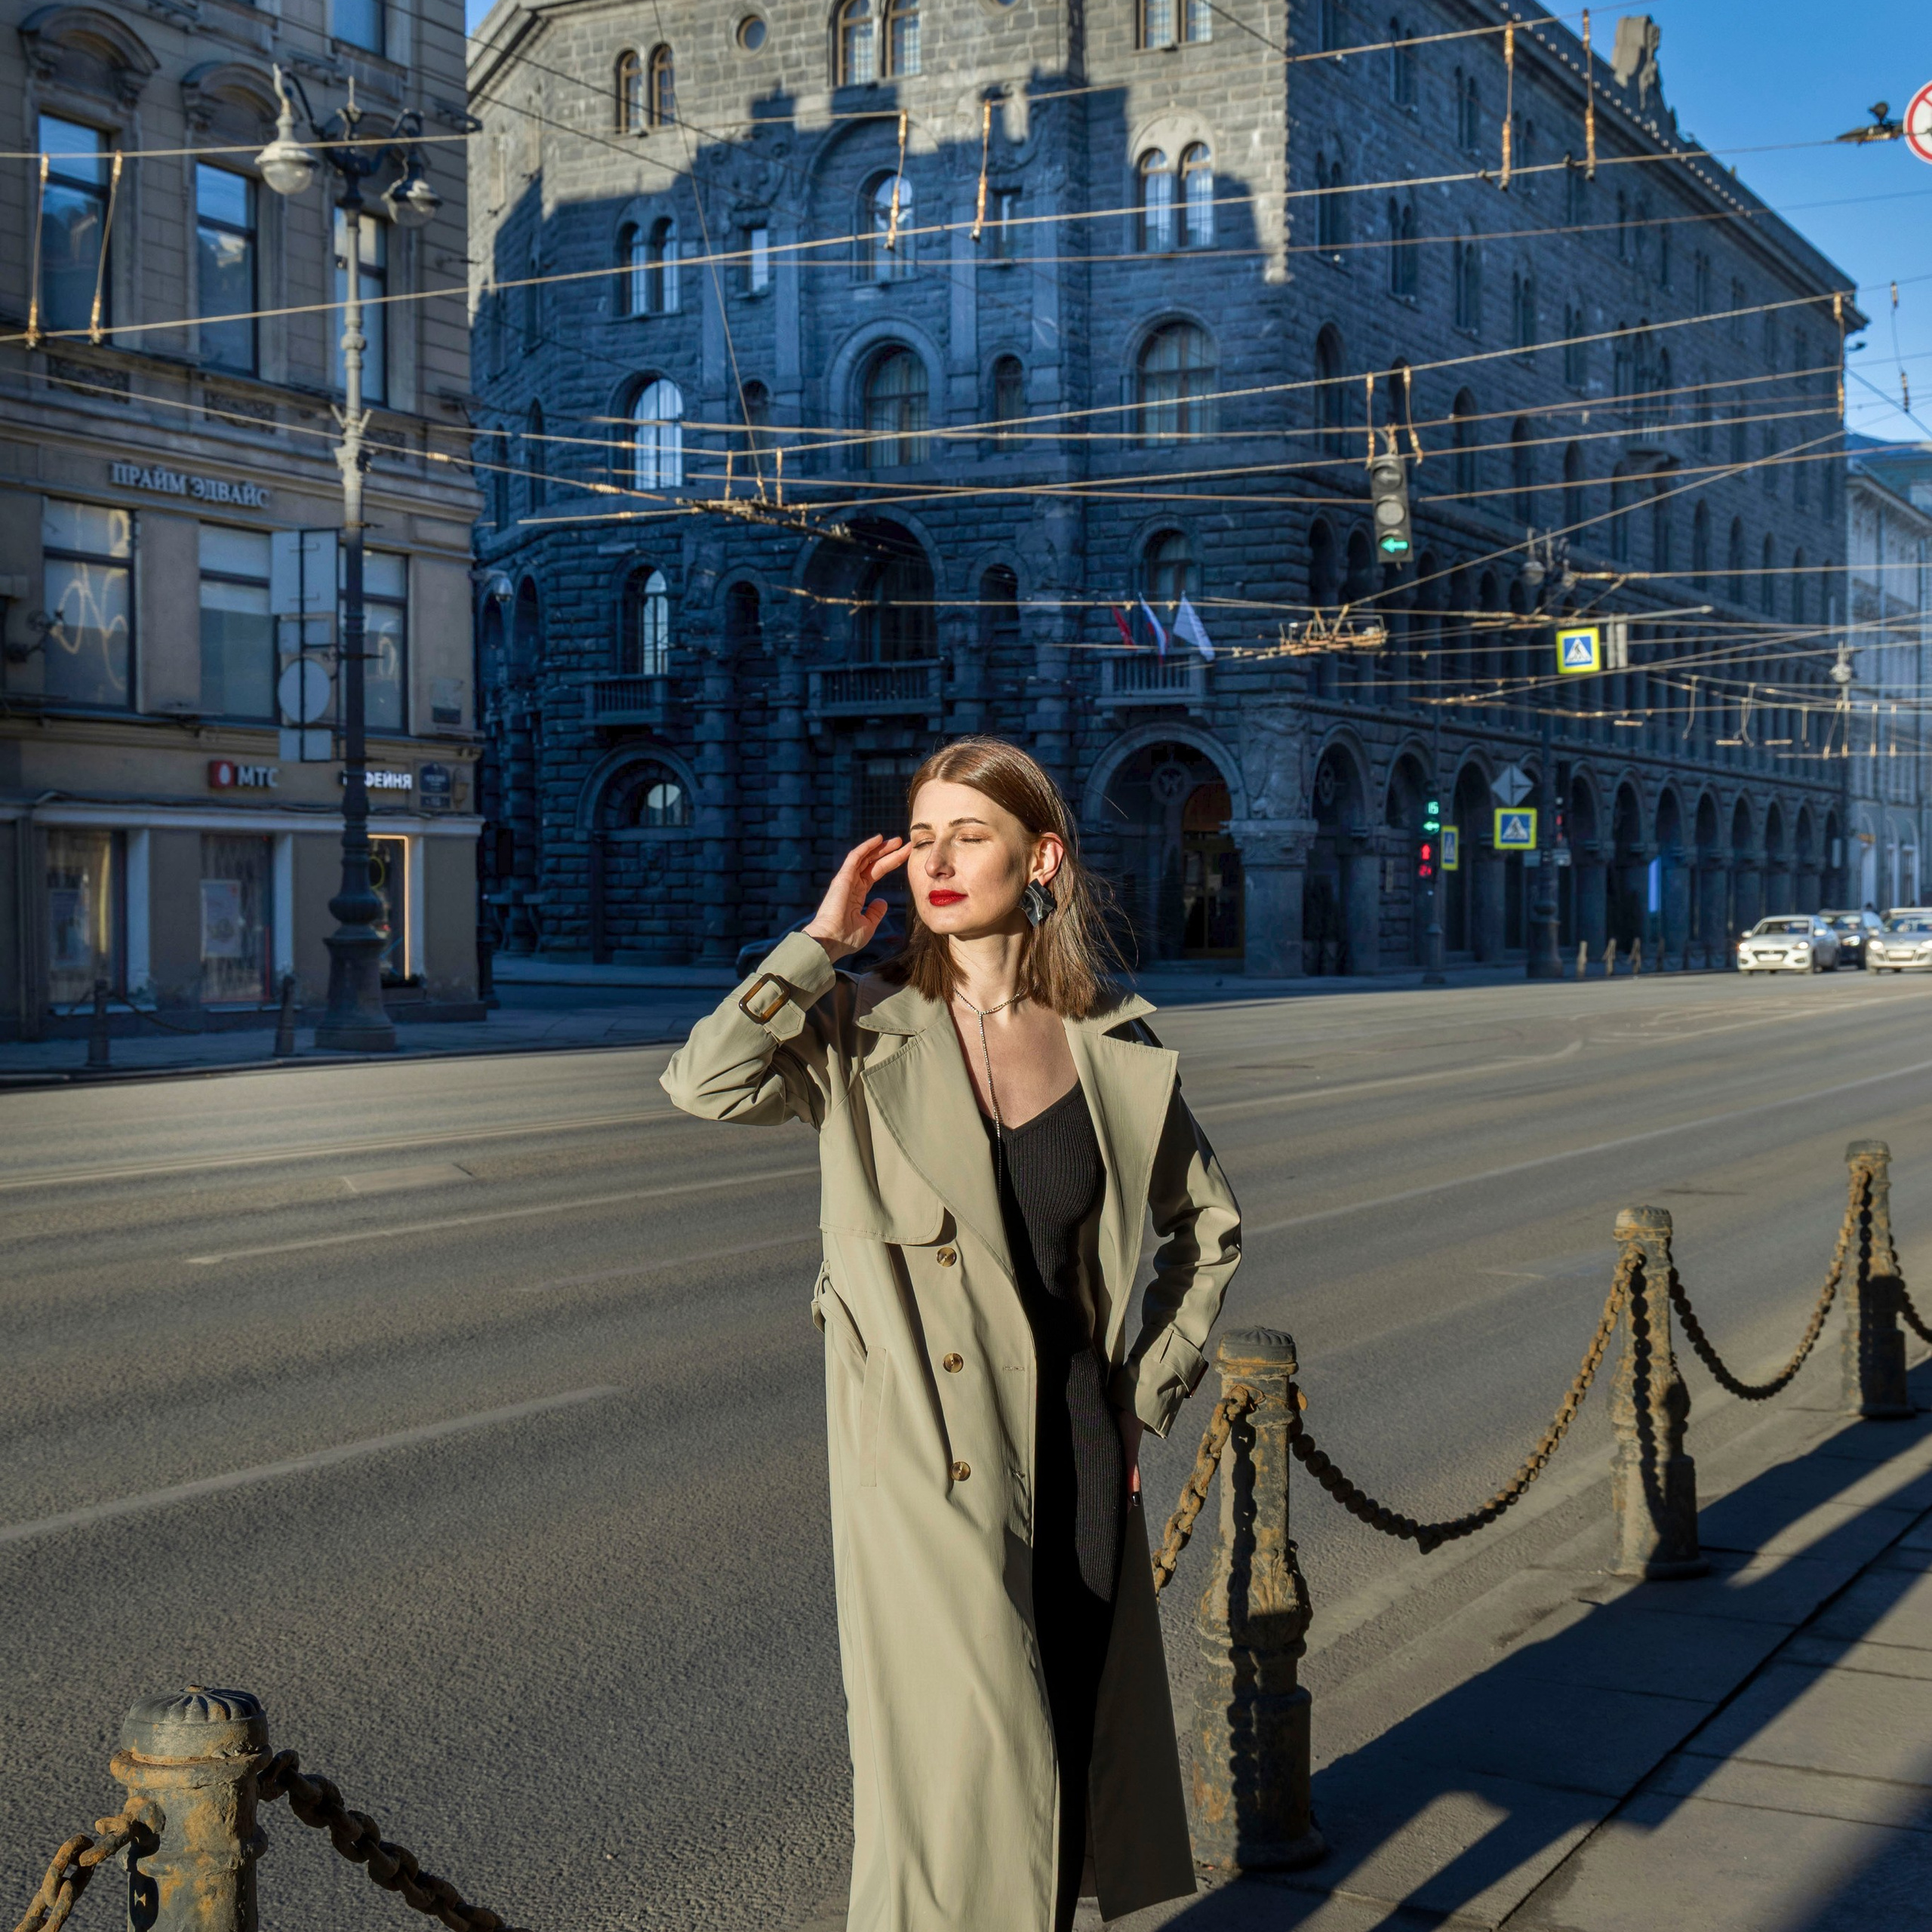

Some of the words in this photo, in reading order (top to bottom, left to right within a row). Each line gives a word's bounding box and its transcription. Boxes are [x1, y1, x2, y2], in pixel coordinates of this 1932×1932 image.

[111, 461, 187, 495] ПРАЙМ
[190, 476, 270, 509] ЭДВАЙС
[238, 764, 279, 787] МТС
[343, 770, 413, 789] ФЕЙНЯ
